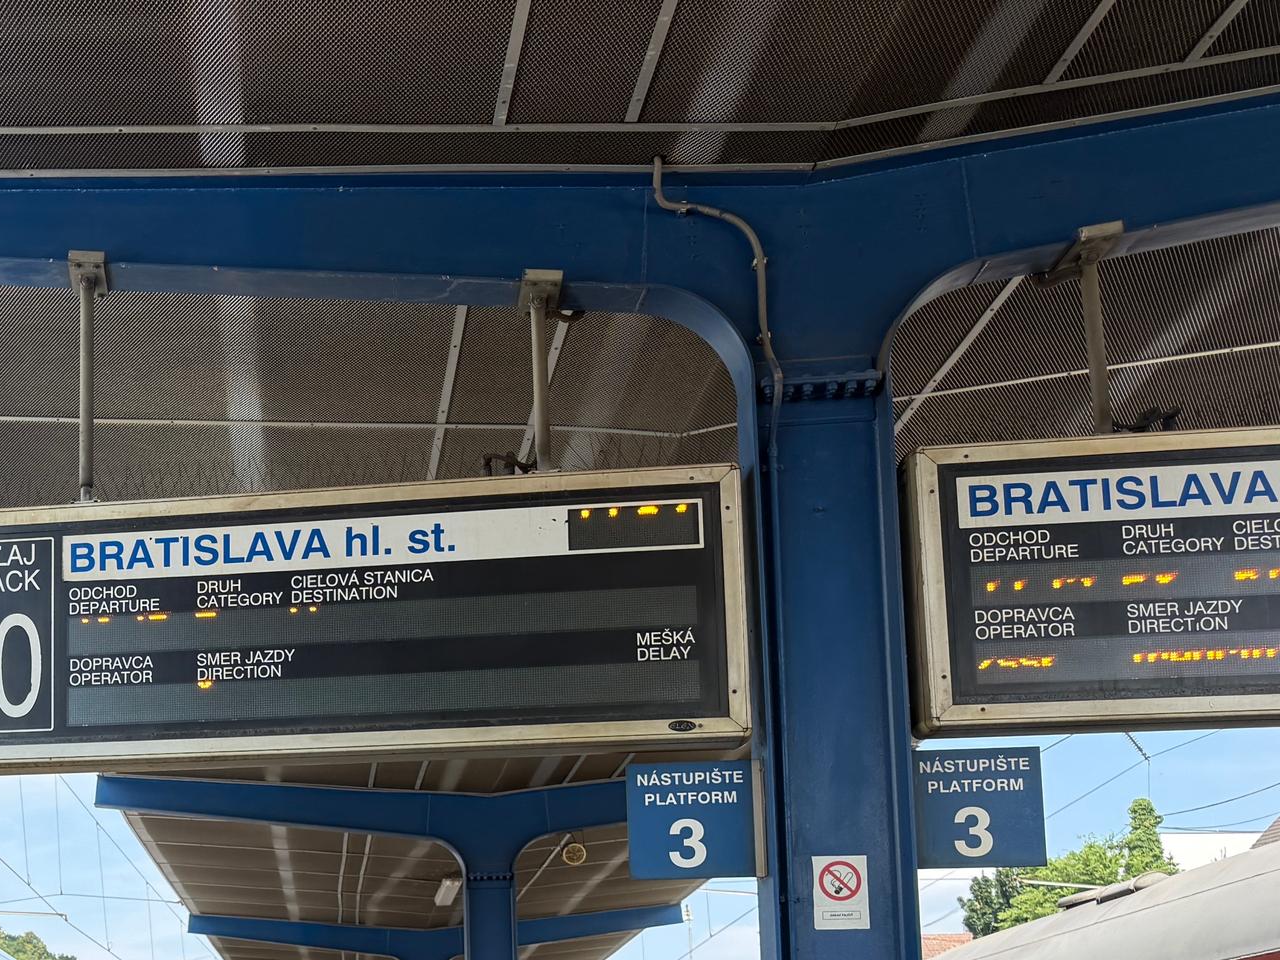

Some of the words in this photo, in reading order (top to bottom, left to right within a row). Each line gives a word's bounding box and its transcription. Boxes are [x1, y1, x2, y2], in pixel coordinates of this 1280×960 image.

[968, 470, 1278, 518] BRATISLAVA
[969, 529, 1050, 547] ODCHOD
[1122, 523, 1175, 539] DRUH
[70, 528, 331, 573] BRATISLAVA
[345, 524, 392, 558] hl.
[407, 522, 456, 553] st.
[970, 544, 1079, 563] DEPARTURE
[1123, 537, 1225, 556] CATEGORY
[197, 579, 241, 594] DRUH
[291, 569, 360, 589] CIEĽOVÁ
[364, 568, 434, 585] STANICA
[69, 585, 137, 600] ODCHOD
[197, 592, 283, 609] CATEGORY
[291, 585, 398, 604] DESTINATION
[69, 598, 160, 615] DEPARTURE
[974, 606, 1075, 624] DOPRAVCA
[1127, 602, 1179, 618] SMER
[1184, 599, 1243, 616] JAZDY
[975, 622, 1075, 641] OPERATOR
[1128, 616, 1228, 634] DIRECTION
[636, 627, 696, 646] MEŠKÁ
[197, 652, 241, 666] SMER
[245, 649, 295, 665] JAZDY
[637, 646, 692, 661] DELAY
[69, 656, 154, 672] DOPRAVCA
[197, 664, 282, 681] DIRECTION
[69, 671, 153, 686] OPERATOR
[919, 755, 1030, 774] NÁSTUPIŠTE
[636, 767, 744, 787] NÁSTUPIŠTE
[928, 778, 1024, 793] PLATFORM
[644, 791, 738, 806] PLATFORM
[954, 806, 994, 857] 3
[669, 818, 707, 868] 3
